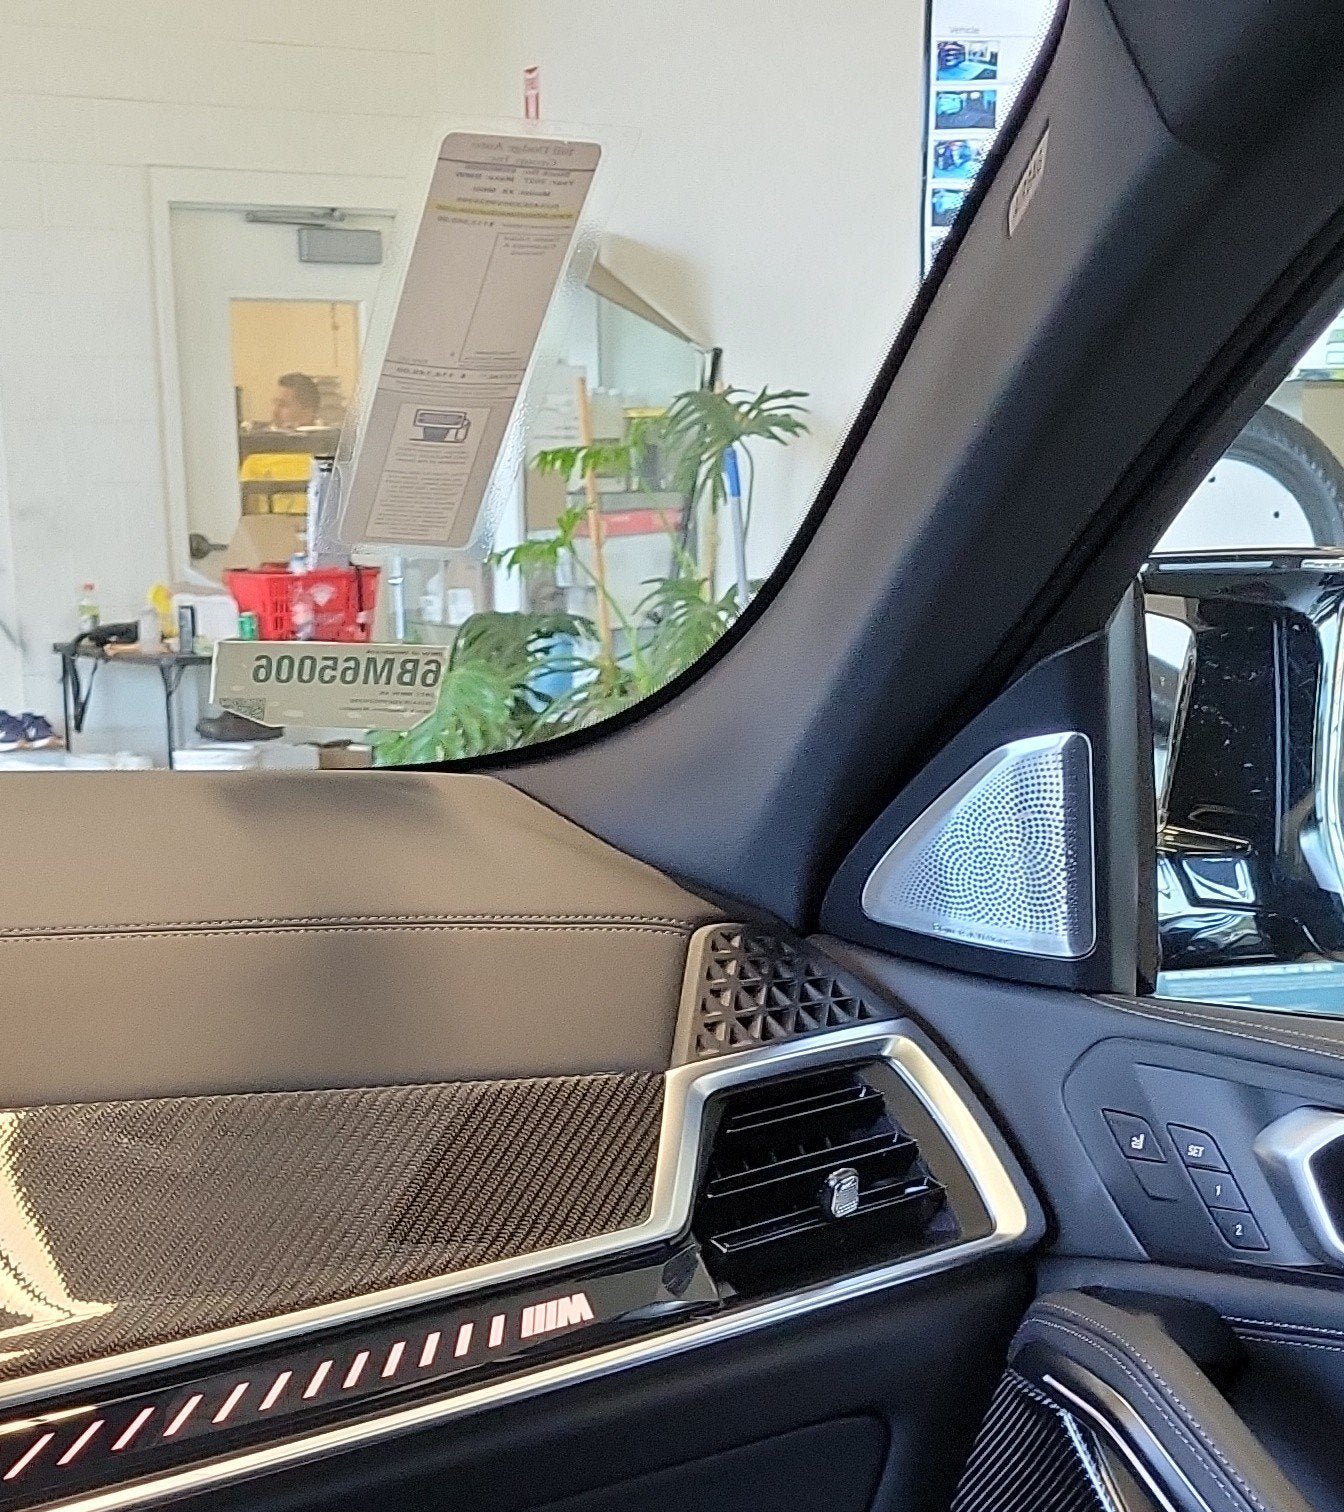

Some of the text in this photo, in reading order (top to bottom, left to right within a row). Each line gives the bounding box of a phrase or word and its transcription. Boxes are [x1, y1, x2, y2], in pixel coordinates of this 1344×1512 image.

[1187, 1144, 1205, 1158] SET
[1215, 1185, 1222, 1196] 1
[1234, 1223, 1244, 1236] 2
